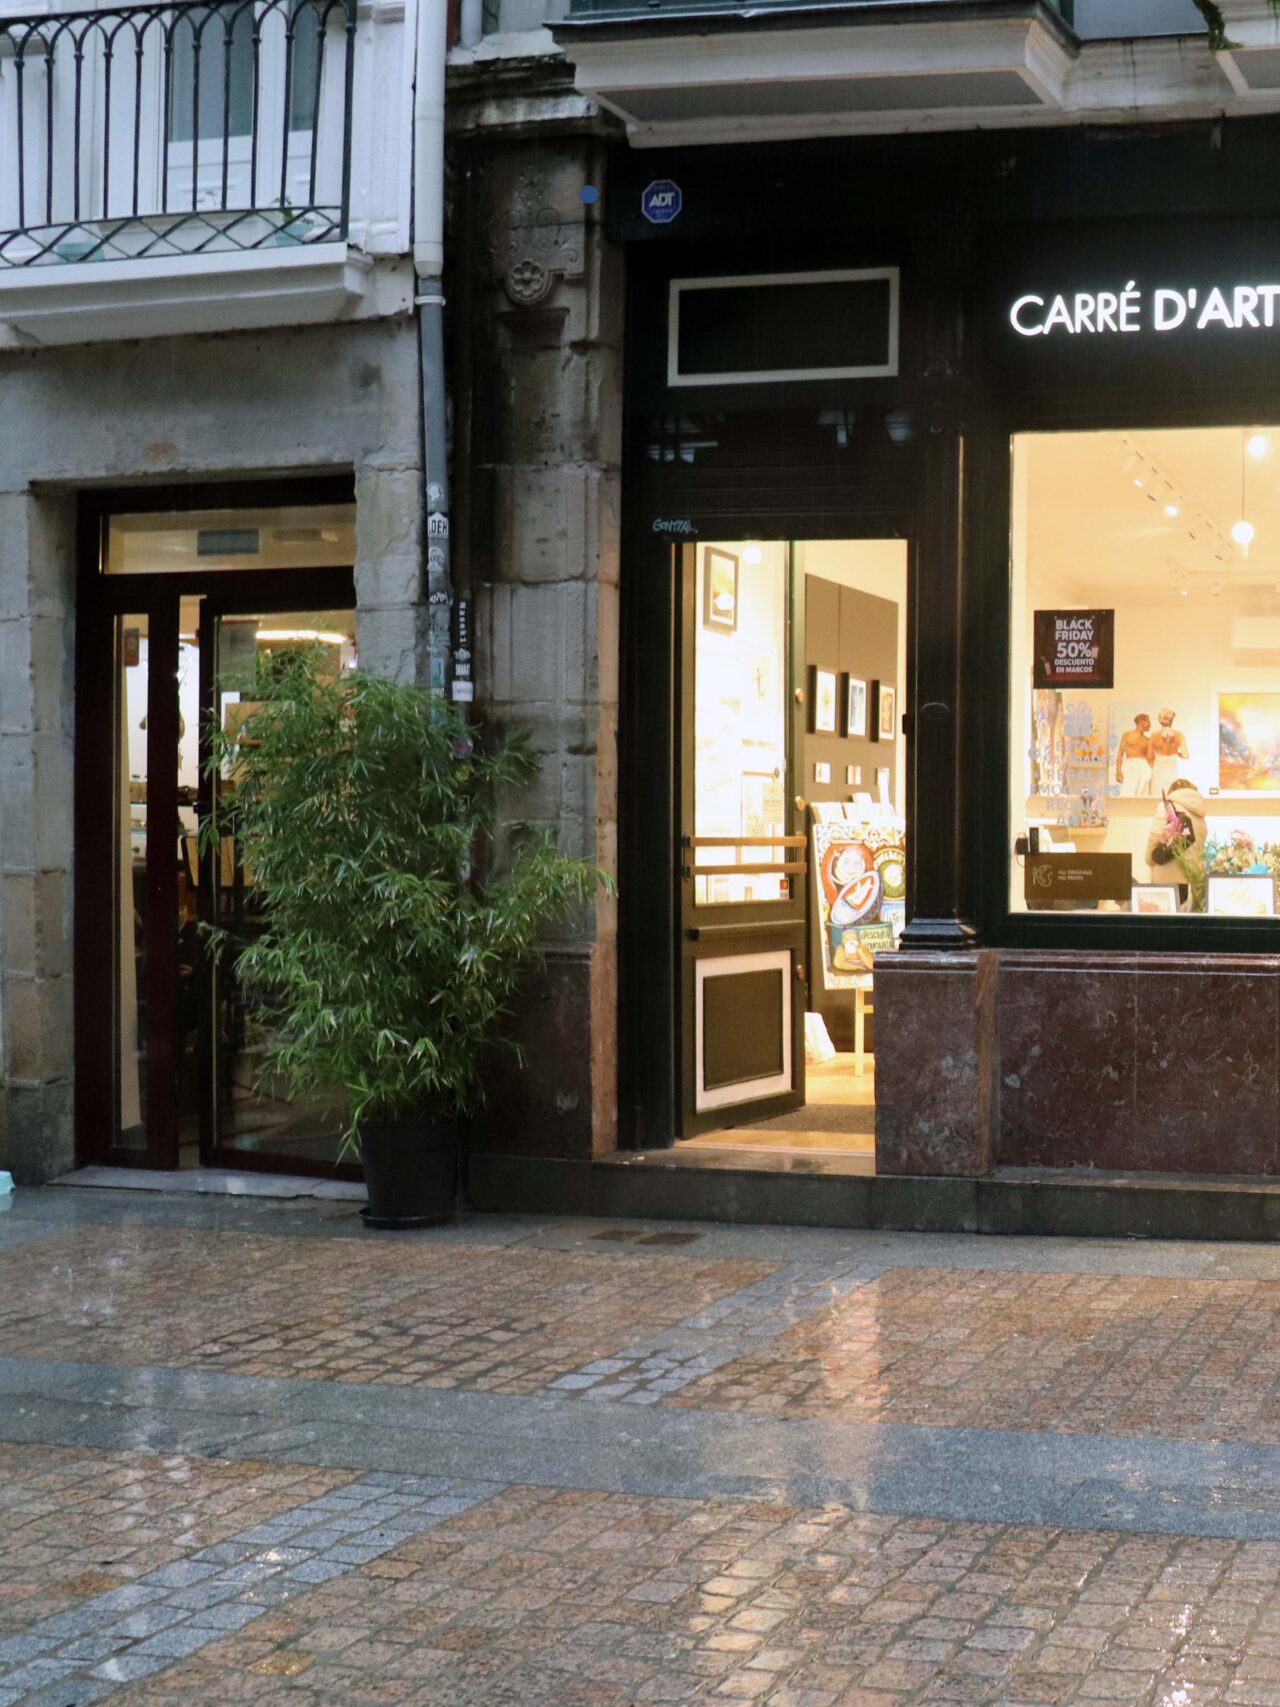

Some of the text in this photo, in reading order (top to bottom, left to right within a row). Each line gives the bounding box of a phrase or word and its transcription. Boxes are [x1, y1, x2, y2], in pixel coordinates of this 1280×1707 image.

[649, 192, 675, 208] ADT
[1010, 280, 1141, 336] CARRÉ
[1055, 619, 1093, 630] BLACK
[1055, 630, 1094, 641] FRIDAY
[1056, 641, 1092, 658] 50%
[1054, 658, 1095, 666] DESCUENTO
